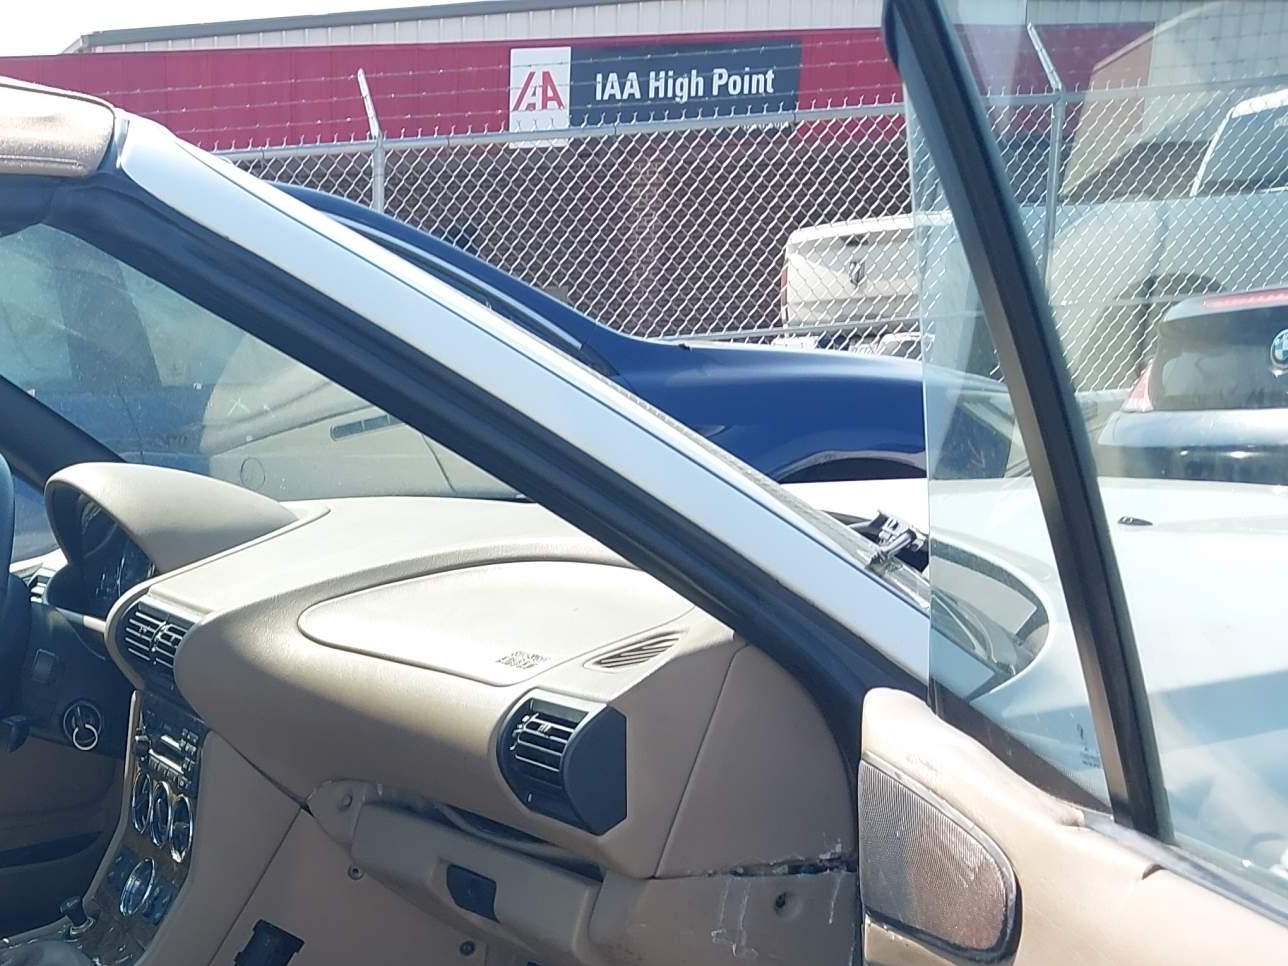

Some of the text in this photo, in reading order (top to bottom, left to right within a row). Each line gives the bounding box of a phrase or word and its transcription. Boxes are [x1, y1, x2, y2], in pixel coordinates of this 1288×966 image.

[595, 68, 775, 104] IAA High Point
